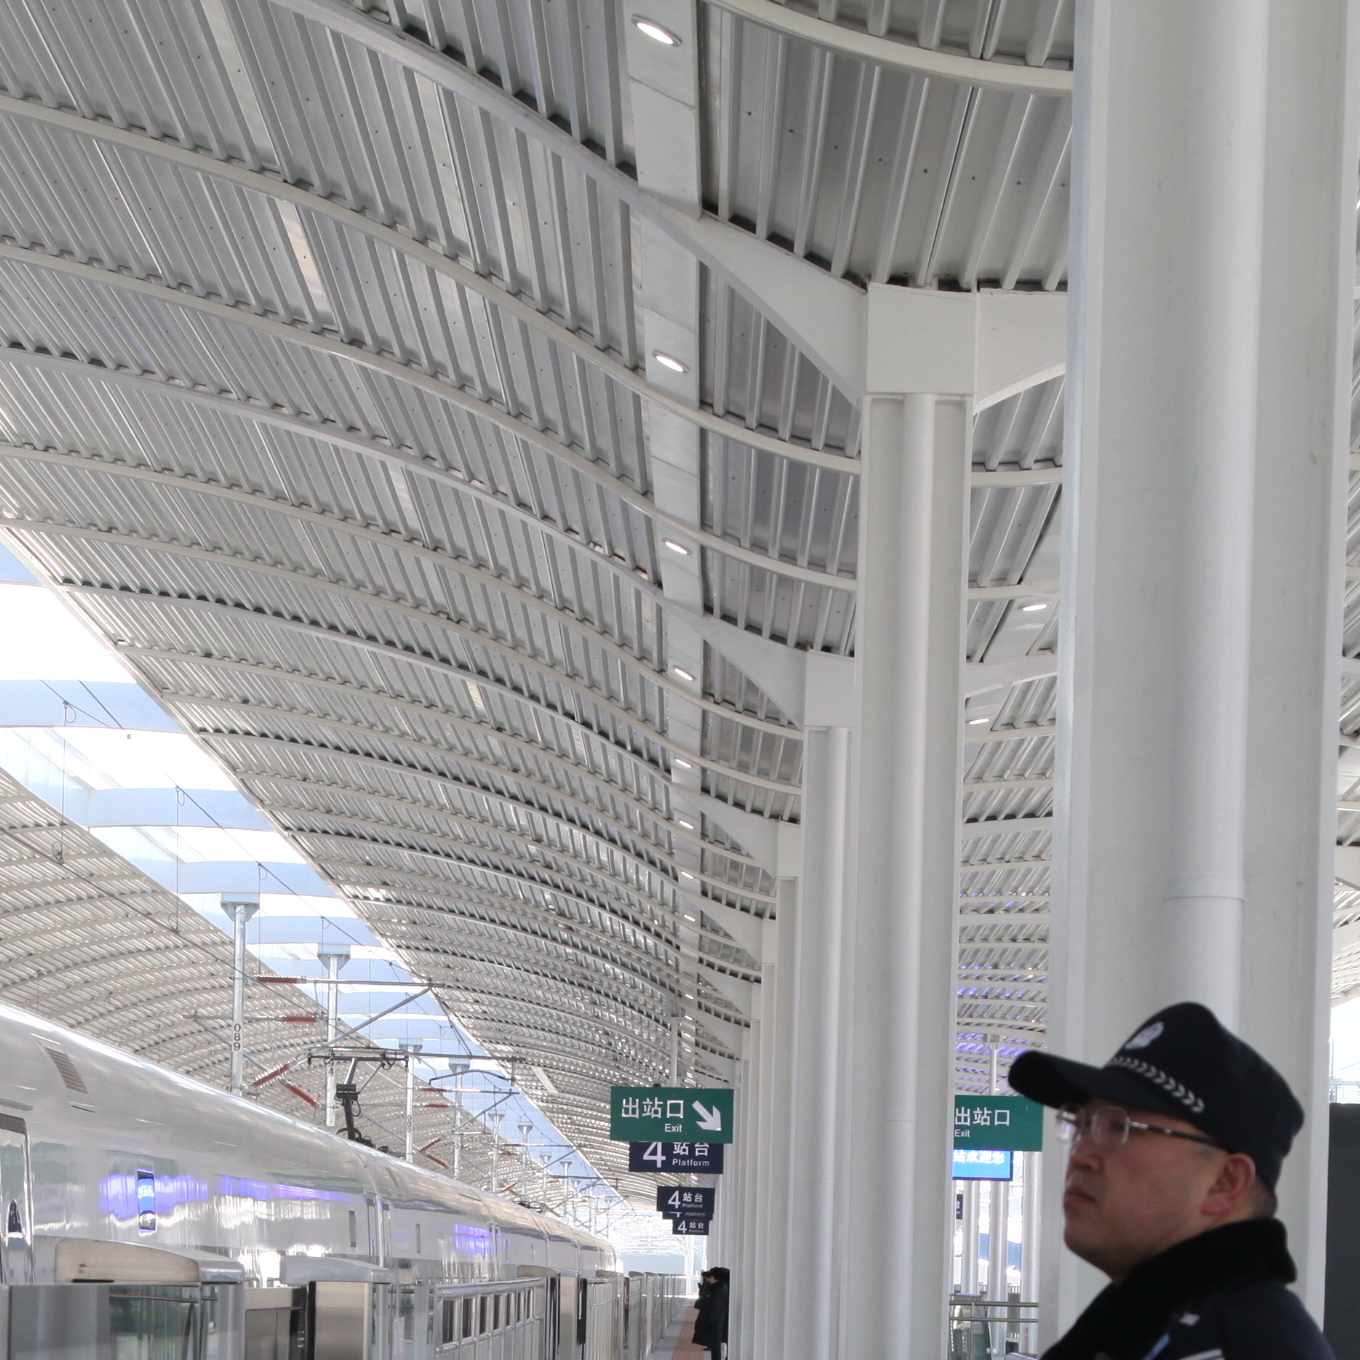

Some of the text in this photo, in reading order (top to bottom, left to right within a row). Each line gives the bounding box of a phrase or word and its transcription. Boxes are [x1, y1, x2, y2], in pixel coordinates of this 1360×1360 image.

[233, 1023, 241, 1051] 089
[622, 1097, 684, 1118] 出站口
[955, 1107, 1010, 1126] 出站口
[664, 1123, 683, 1132] Exit
[955, 1129, 970, 1137] Exit
[643, 1141, 709, 1168] 4 站台
[672, 1158, 710, 1166] Platform
[668, 1190, 703, 1209] 4 站台
[677, 1220, 687, 1233] 4
